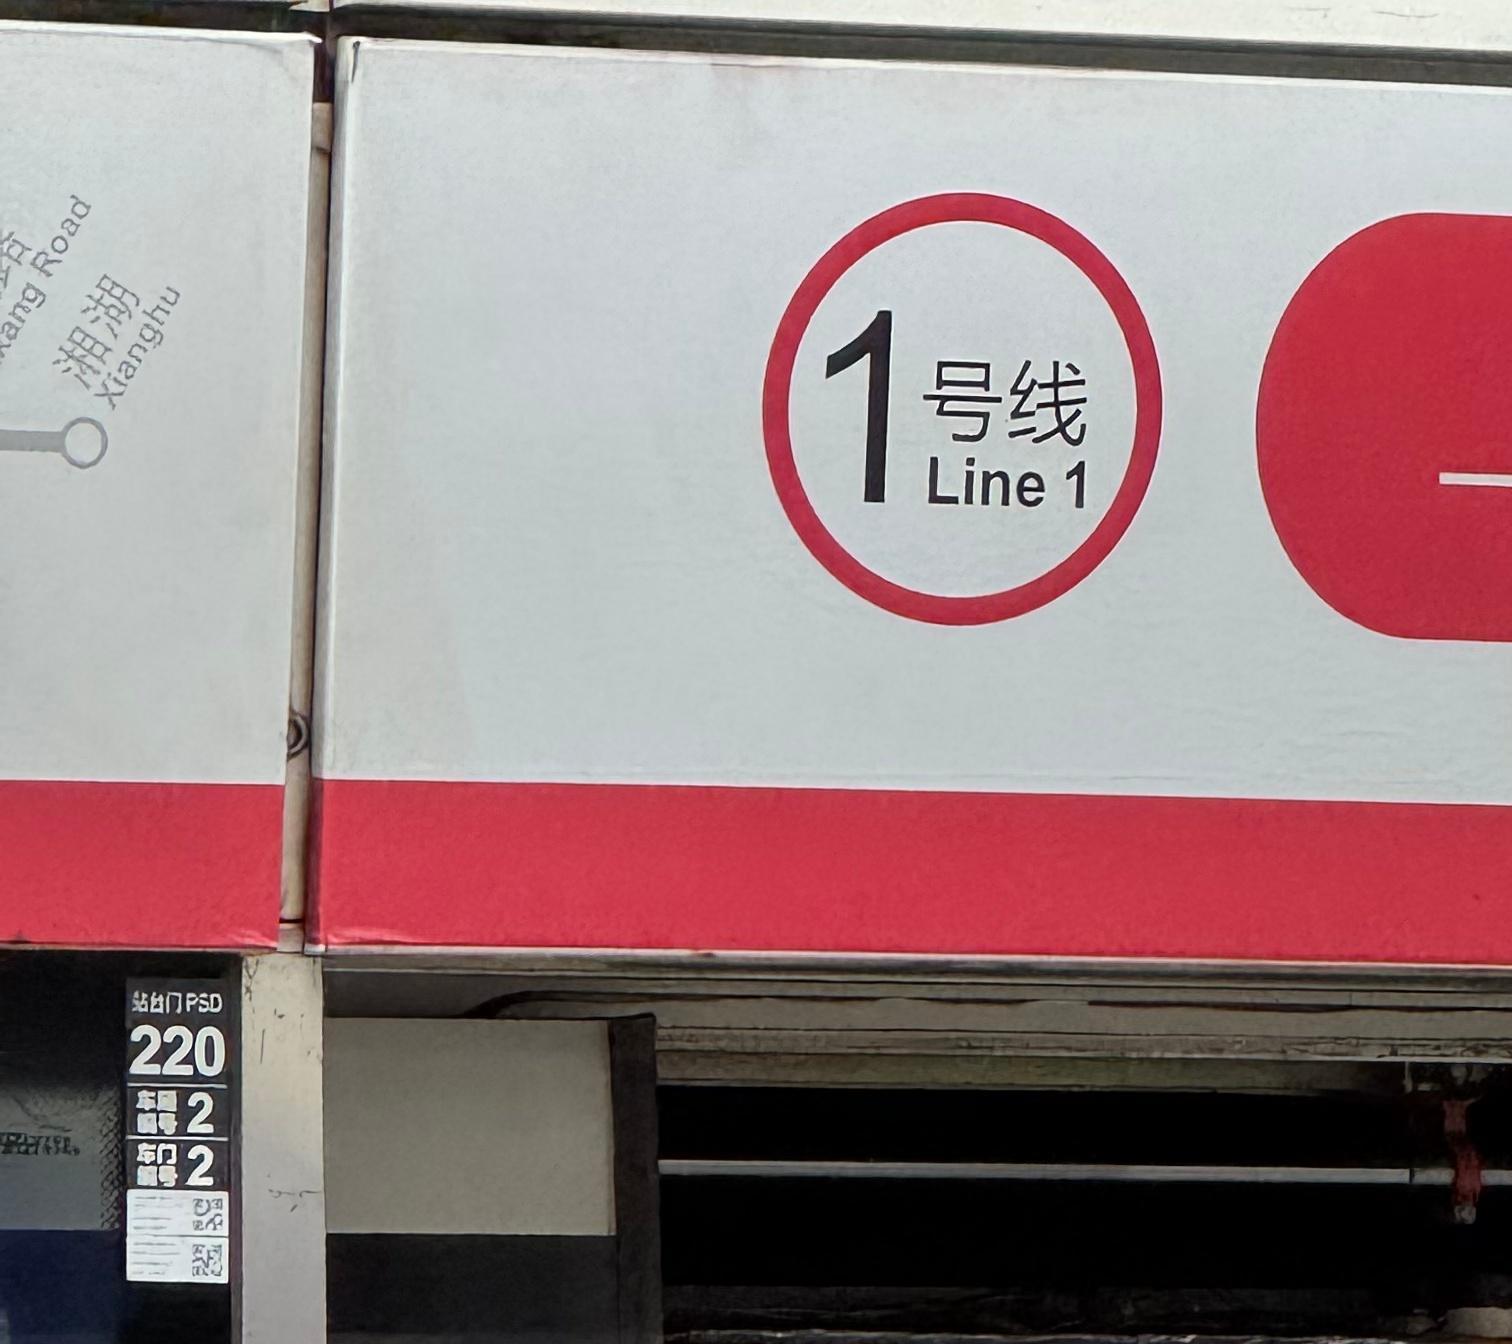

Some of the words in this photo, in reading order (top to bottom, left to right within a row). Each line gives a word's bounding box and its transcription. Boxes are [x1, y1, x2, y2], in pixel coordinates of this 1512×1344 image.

[30, 194, 91, 277] Road
[52, 274, 140, 390] 湘湖
[94, 286, 181, 410] Xianghu
[928, 456, 1046, 508] Line
[1065, 460, 1086, 509] 1
[186, 992, 223, 1013] PSD
[129, 1024, 226, 1077] 220
[187, 1091, 214, 1133] 2
[185, 1144, 214, 1186] 2
